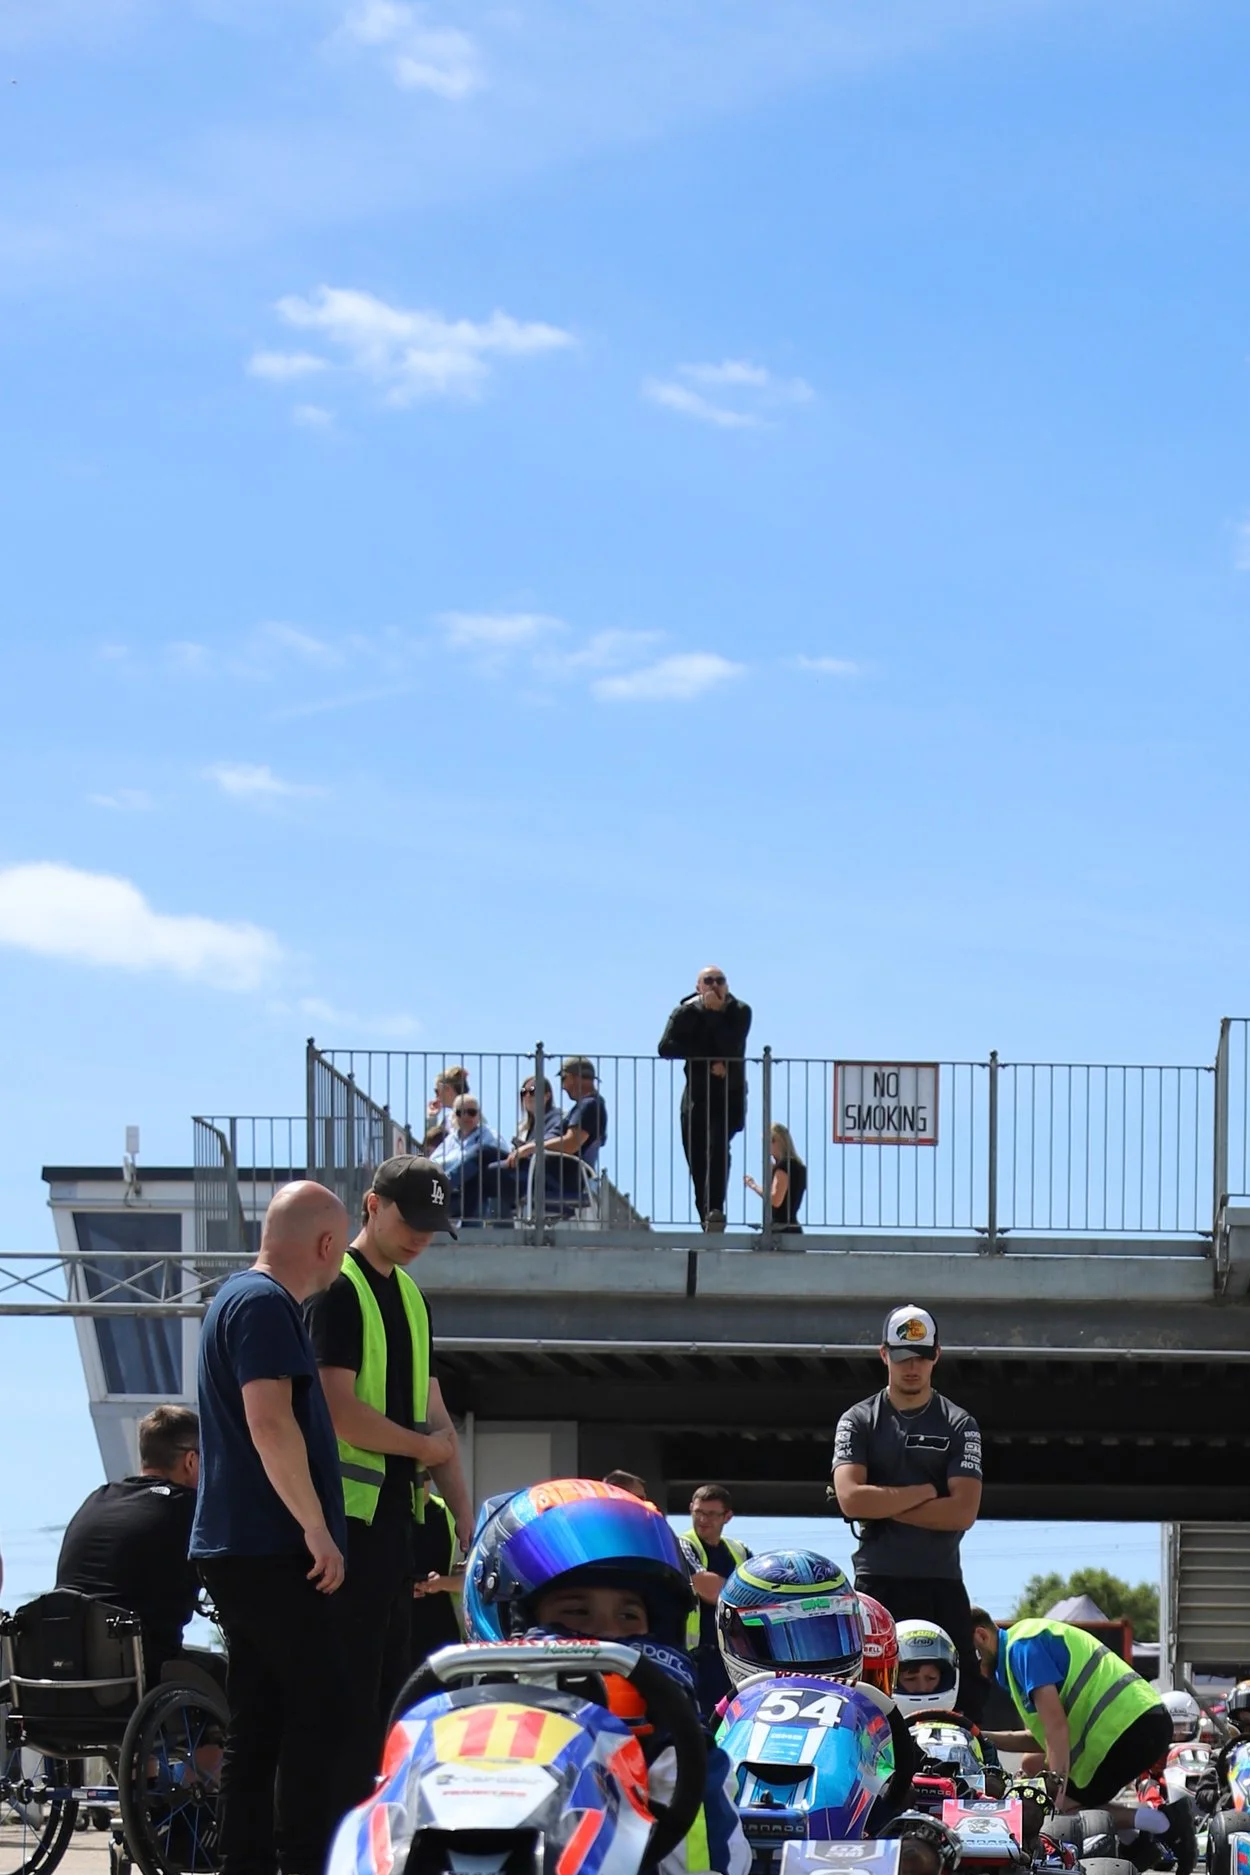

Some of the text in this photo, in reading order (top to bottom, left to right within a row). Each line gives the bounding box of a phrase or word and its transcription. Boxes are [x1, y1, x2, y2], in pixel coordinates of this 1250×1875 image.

[873, 1071, 899, 1098] NO
[845, 1104, 927, 1132] SMOKING
[431, 1179, 445, 1206] LA
[863, 1646, 881, 1654] BELL
[755, 1690, 842, 1728] 54
[457, 1698, 546, 1759] 11
